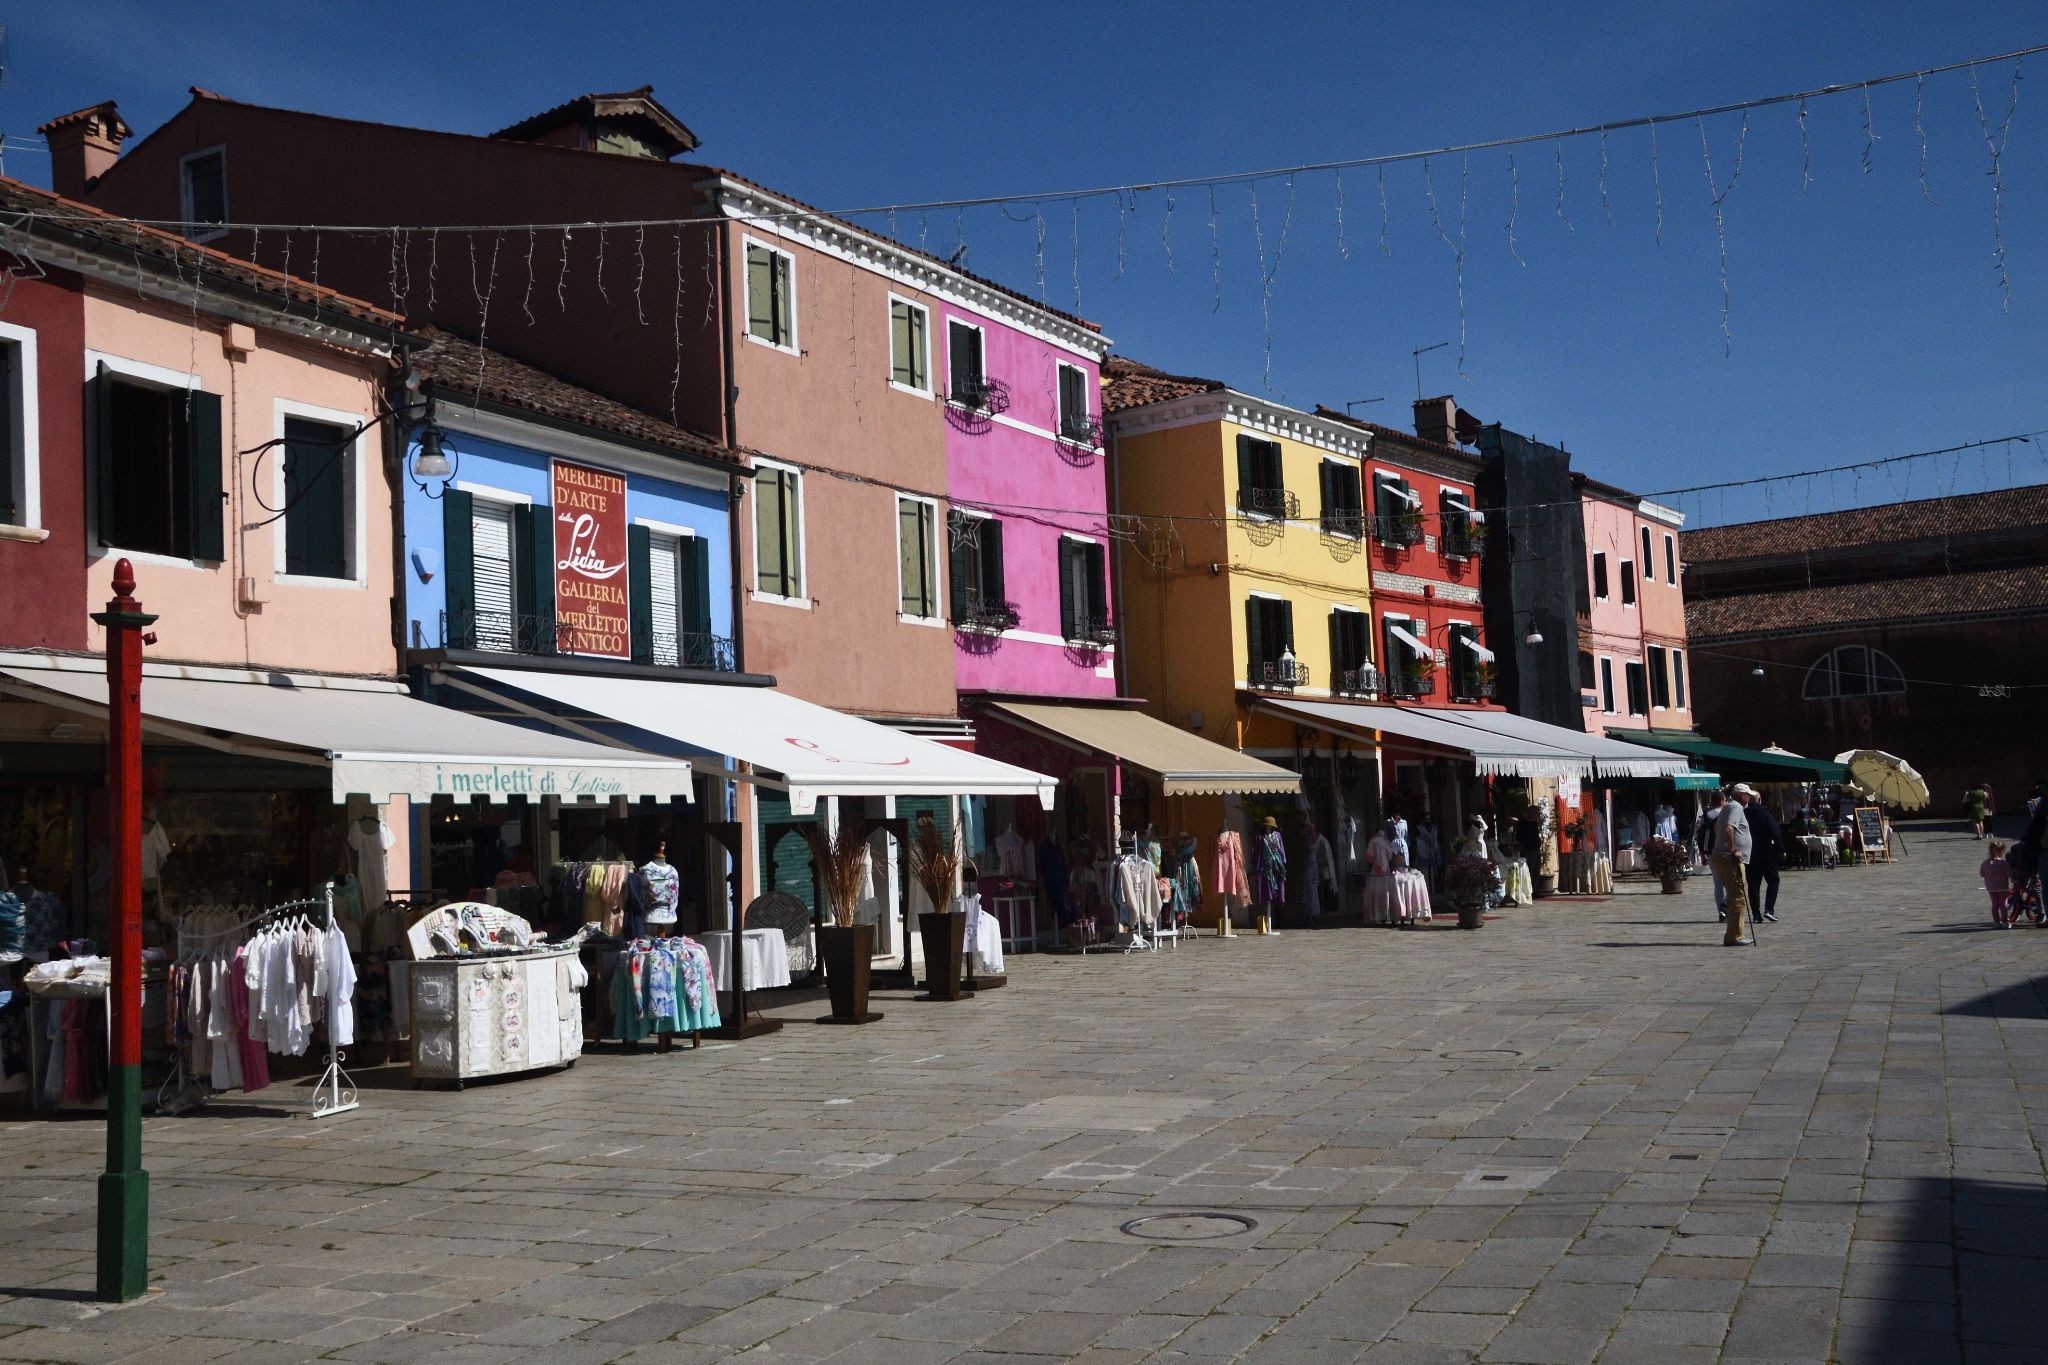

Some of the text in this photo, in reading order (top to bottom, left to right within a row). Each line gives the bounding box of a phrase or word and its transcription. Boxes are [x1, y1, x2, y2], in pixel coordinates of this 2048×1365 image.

[557, 465, 623, 494] MERLETTI
[557, 486, 607, 513] D'ARTE
[557, 513, 626, 579] Lidia
[558, 579, 626, 605] GALLERIA
[586, 600, 600, 615] del
[557, 610, 628, 635] MERLETTO
[566, 631, 622, 653] ANTICO
[1518, 759, 1556, 772] EMILIA
[435, 765, 622, 794] i merletti di Letizia
